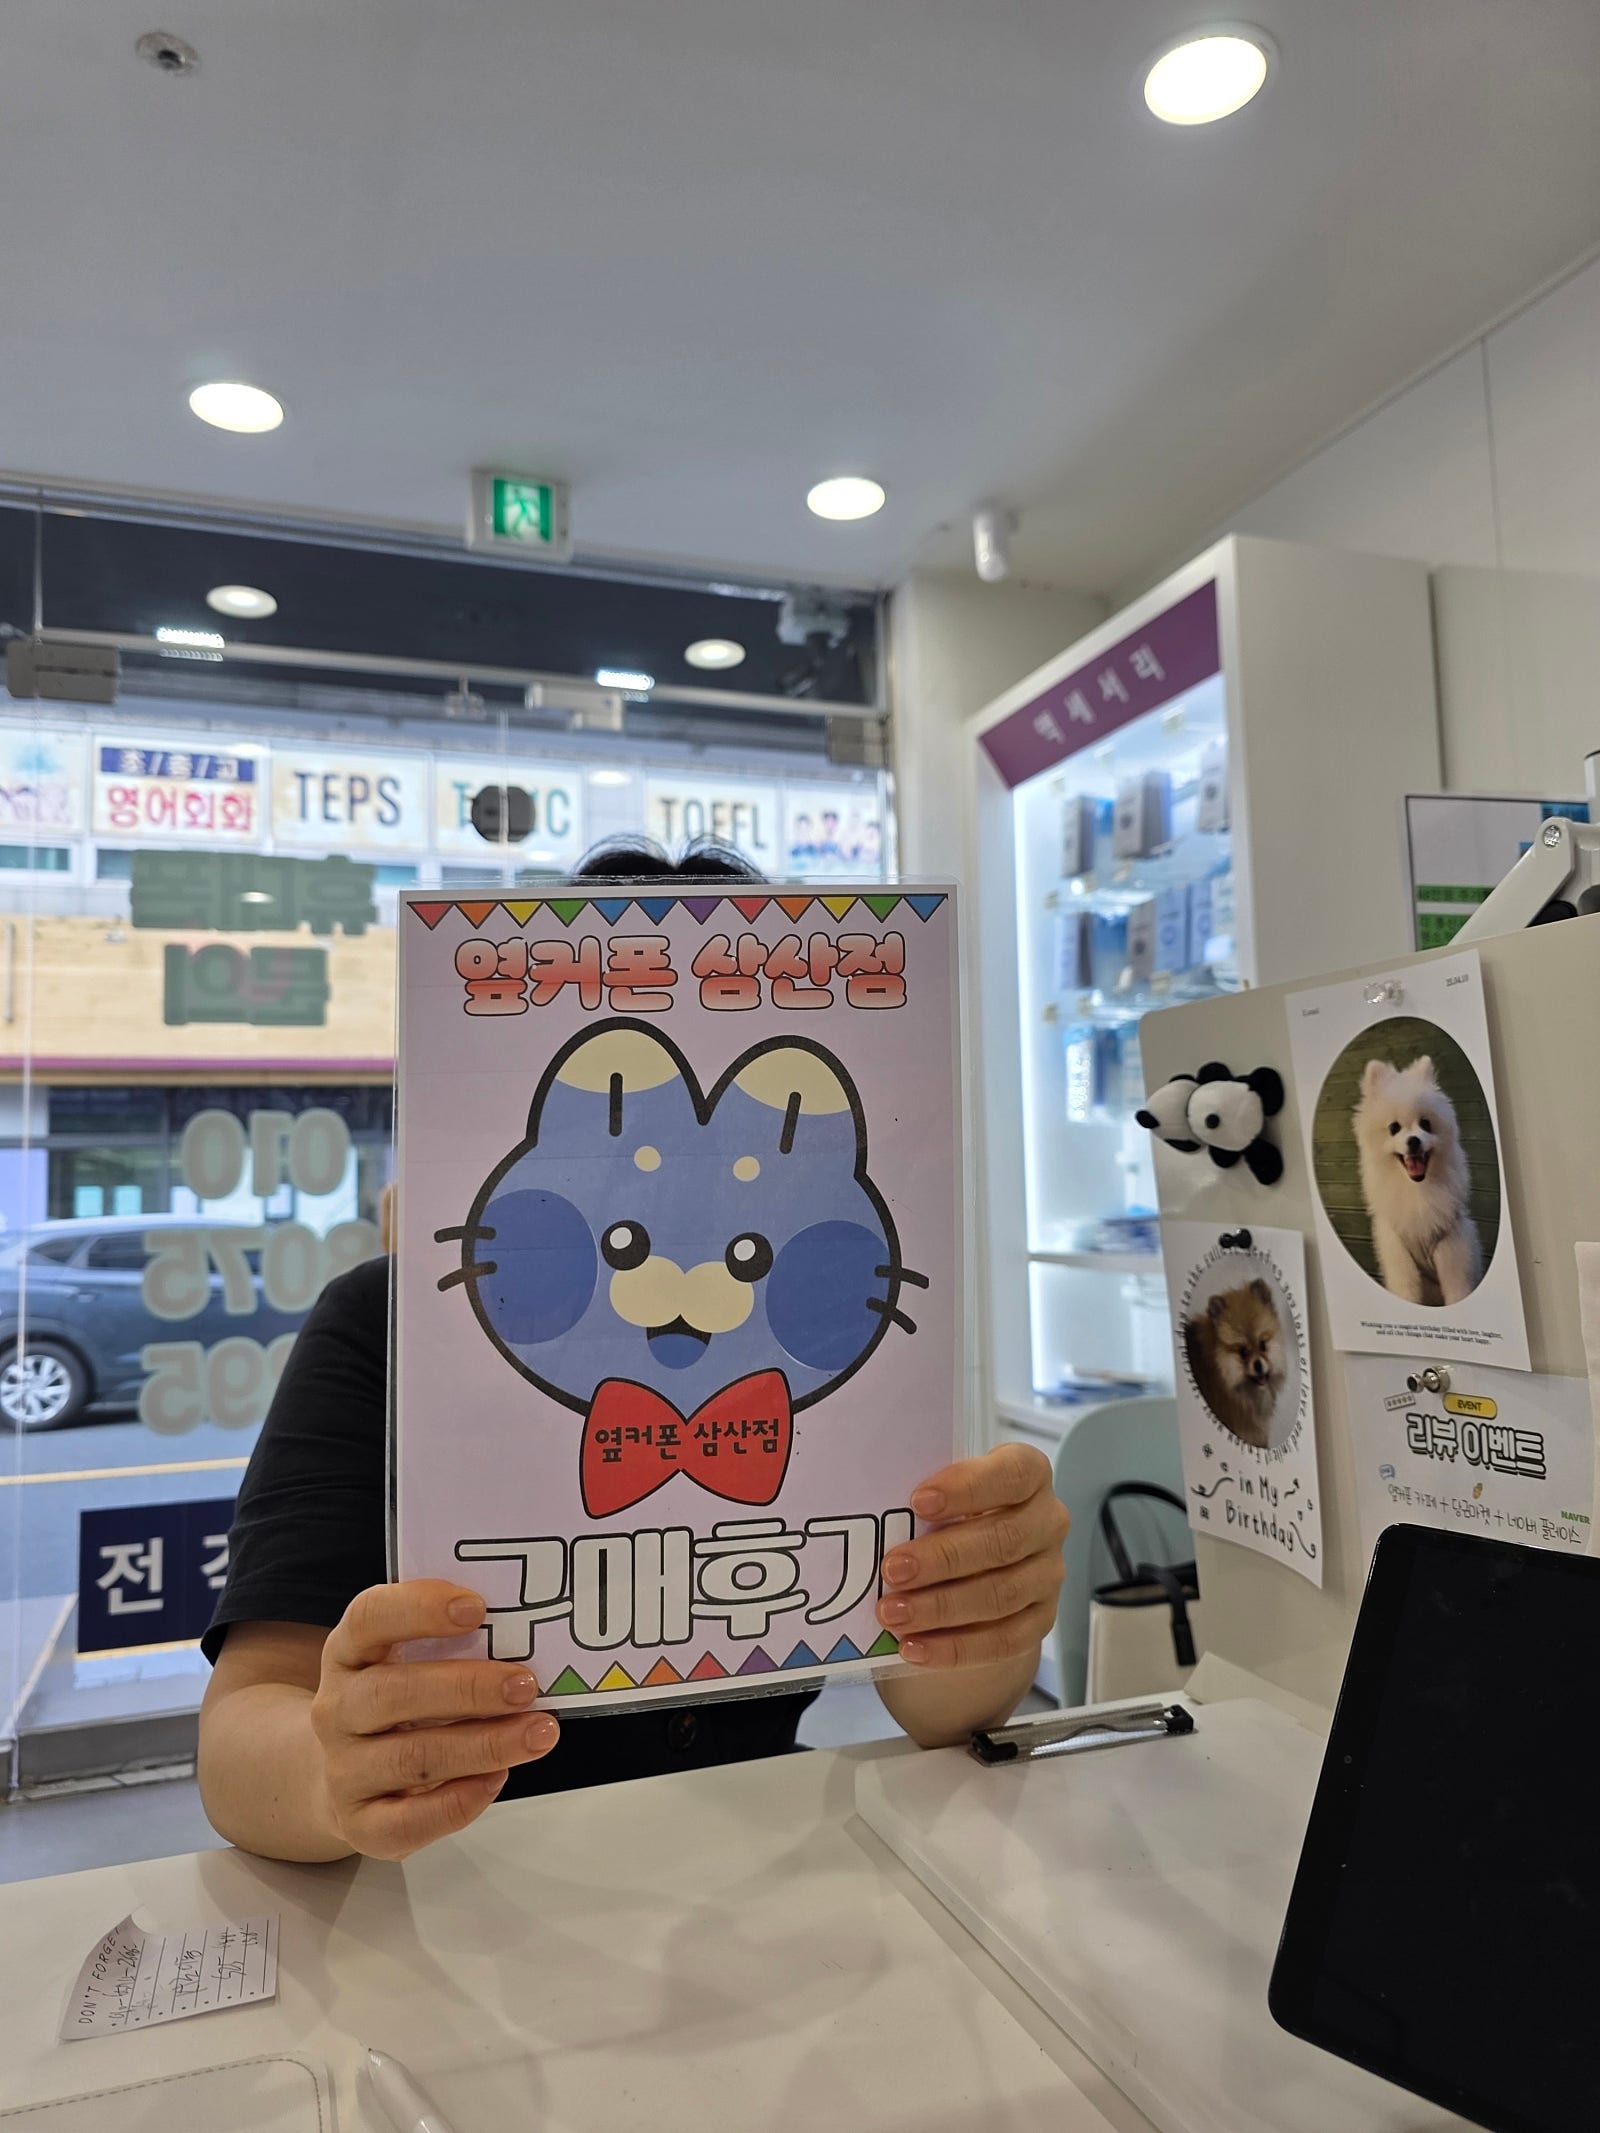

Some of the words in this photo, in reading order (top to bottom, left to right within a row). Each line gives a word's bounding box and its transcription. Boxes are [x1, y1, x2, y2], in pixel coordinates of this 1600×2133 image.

[107, 784, 252, 833] 영어회화
[293, 770, 402, 827] TEPS
[657, 796, 769, 850] TOEFL
[454, 935, 678, 1017] 옆커폰
[691, 931, 907, 1011] 삼산점
[1457, 1400, 1483, 1412] EVENT
[595, 1424, 681, 1463] 옆커폰
[693, 1418, 780, 1457] 삼산점
[1406, 1412, 1459, 1463] 리뷰
[1461, 1421, 1546, 1480] 이벤트
[1238, 1469, 1254, 1495] in
[1259, 1474, 1278, 1507] My
[1225, 1499, 1294, 1552] Birthday
[1539, 1517, 1582, 1544] 플레이스
[1561, 1510, 1591, 1525] NAVER
[454, 1507, 914, 1661] 구매후기
[78, 1985, 98, 2025] DON'T
